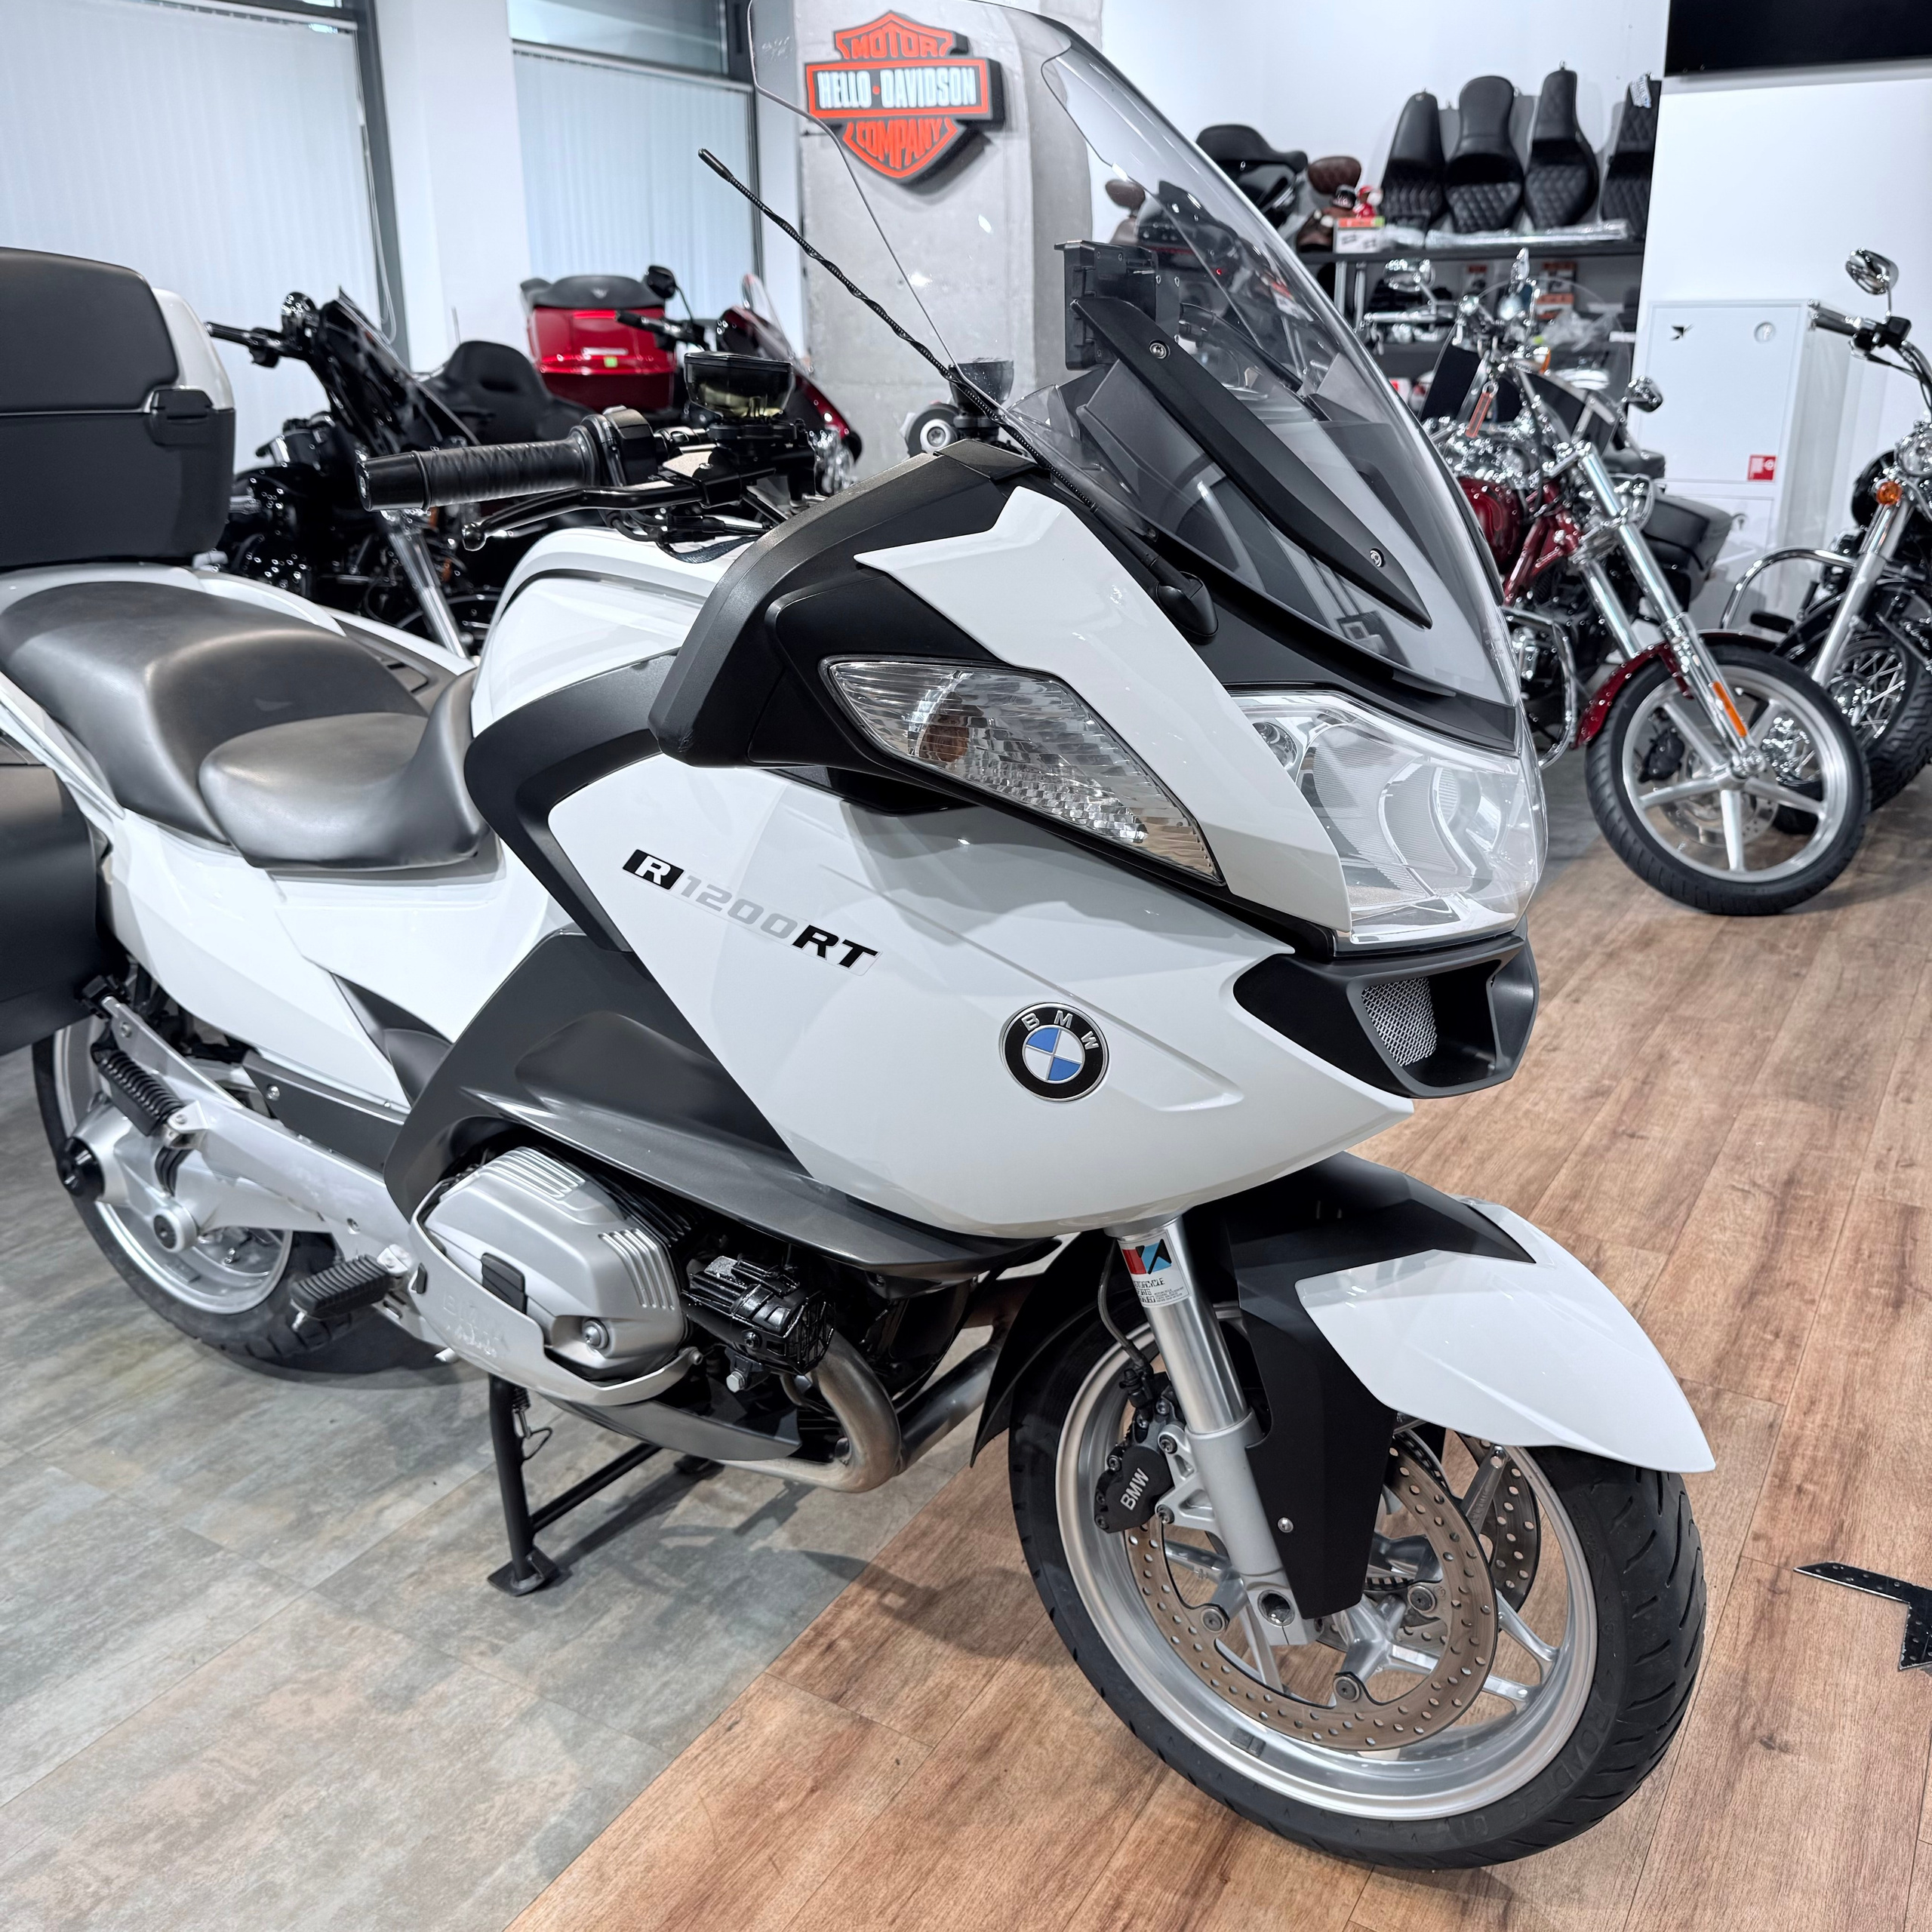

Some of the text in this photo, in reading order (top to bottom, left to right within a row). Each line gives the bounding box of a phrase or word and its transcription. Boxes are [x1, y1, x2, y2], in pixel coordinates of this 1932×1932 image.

[851, 23, 938, 59] MOTOR
[817, 67, 977, 109] HELLO DAVIDSON
[856, 118, 943, 169] COMPANY
[1021, 1010, 1100, 1051] BMW
[1120, 1467, 1149, 1511] BMW
